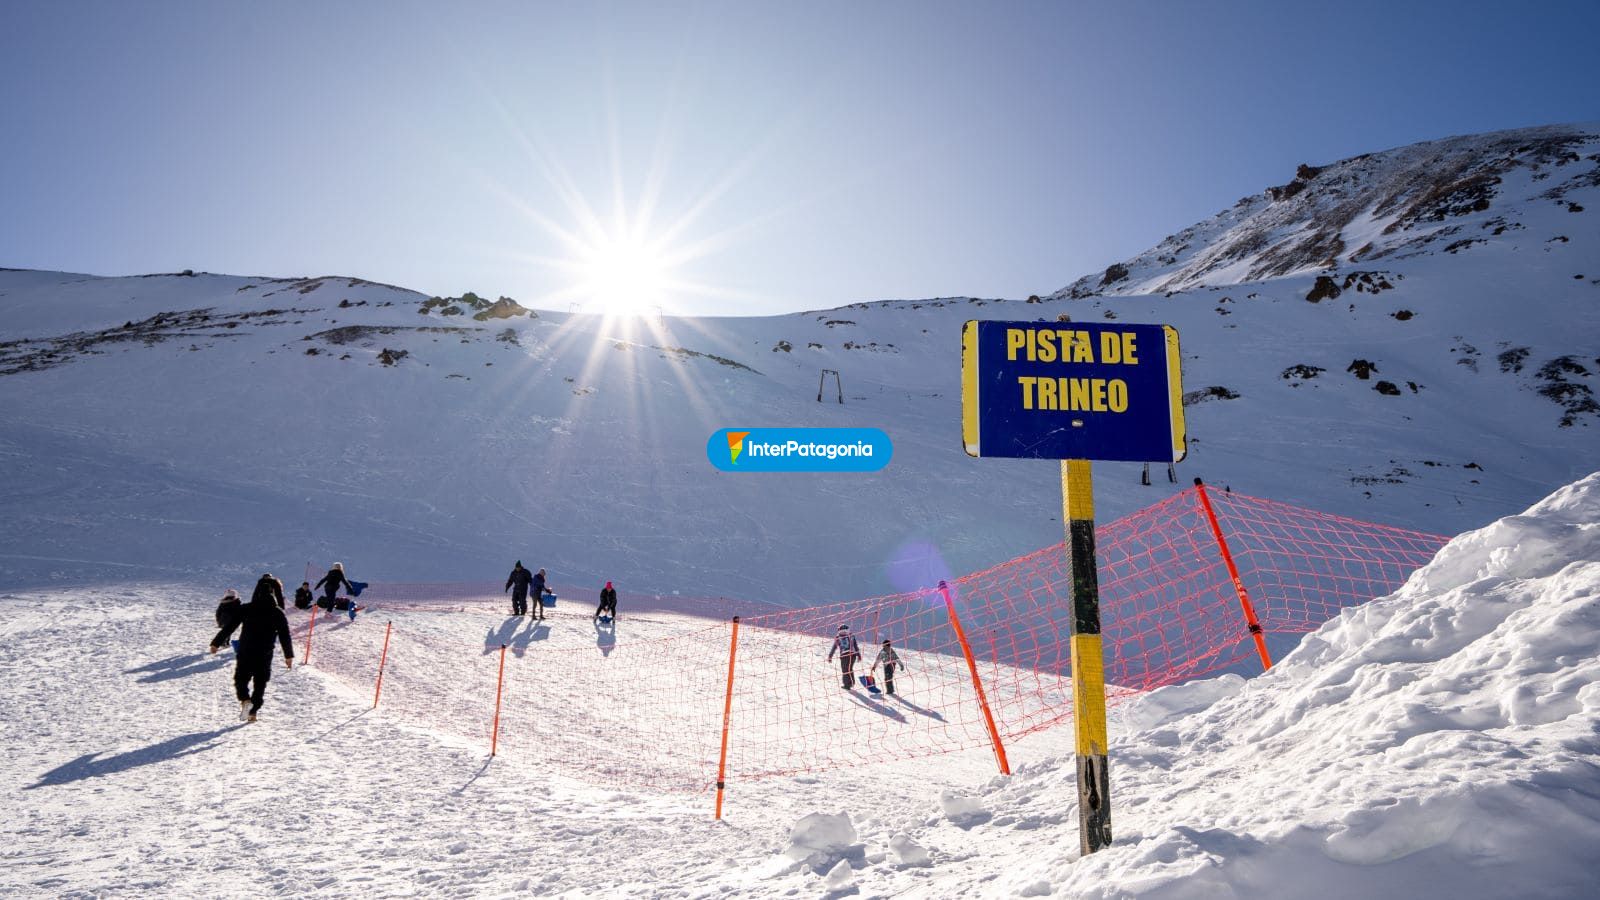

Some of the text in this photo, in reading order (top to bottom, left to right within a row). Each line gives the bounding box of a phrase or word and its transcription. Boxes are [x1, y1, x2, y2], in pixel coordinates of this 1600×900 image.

[1007, 328, 1139, 365] PISTA DE
[1018, 376, 1129, 413] TRINEO
